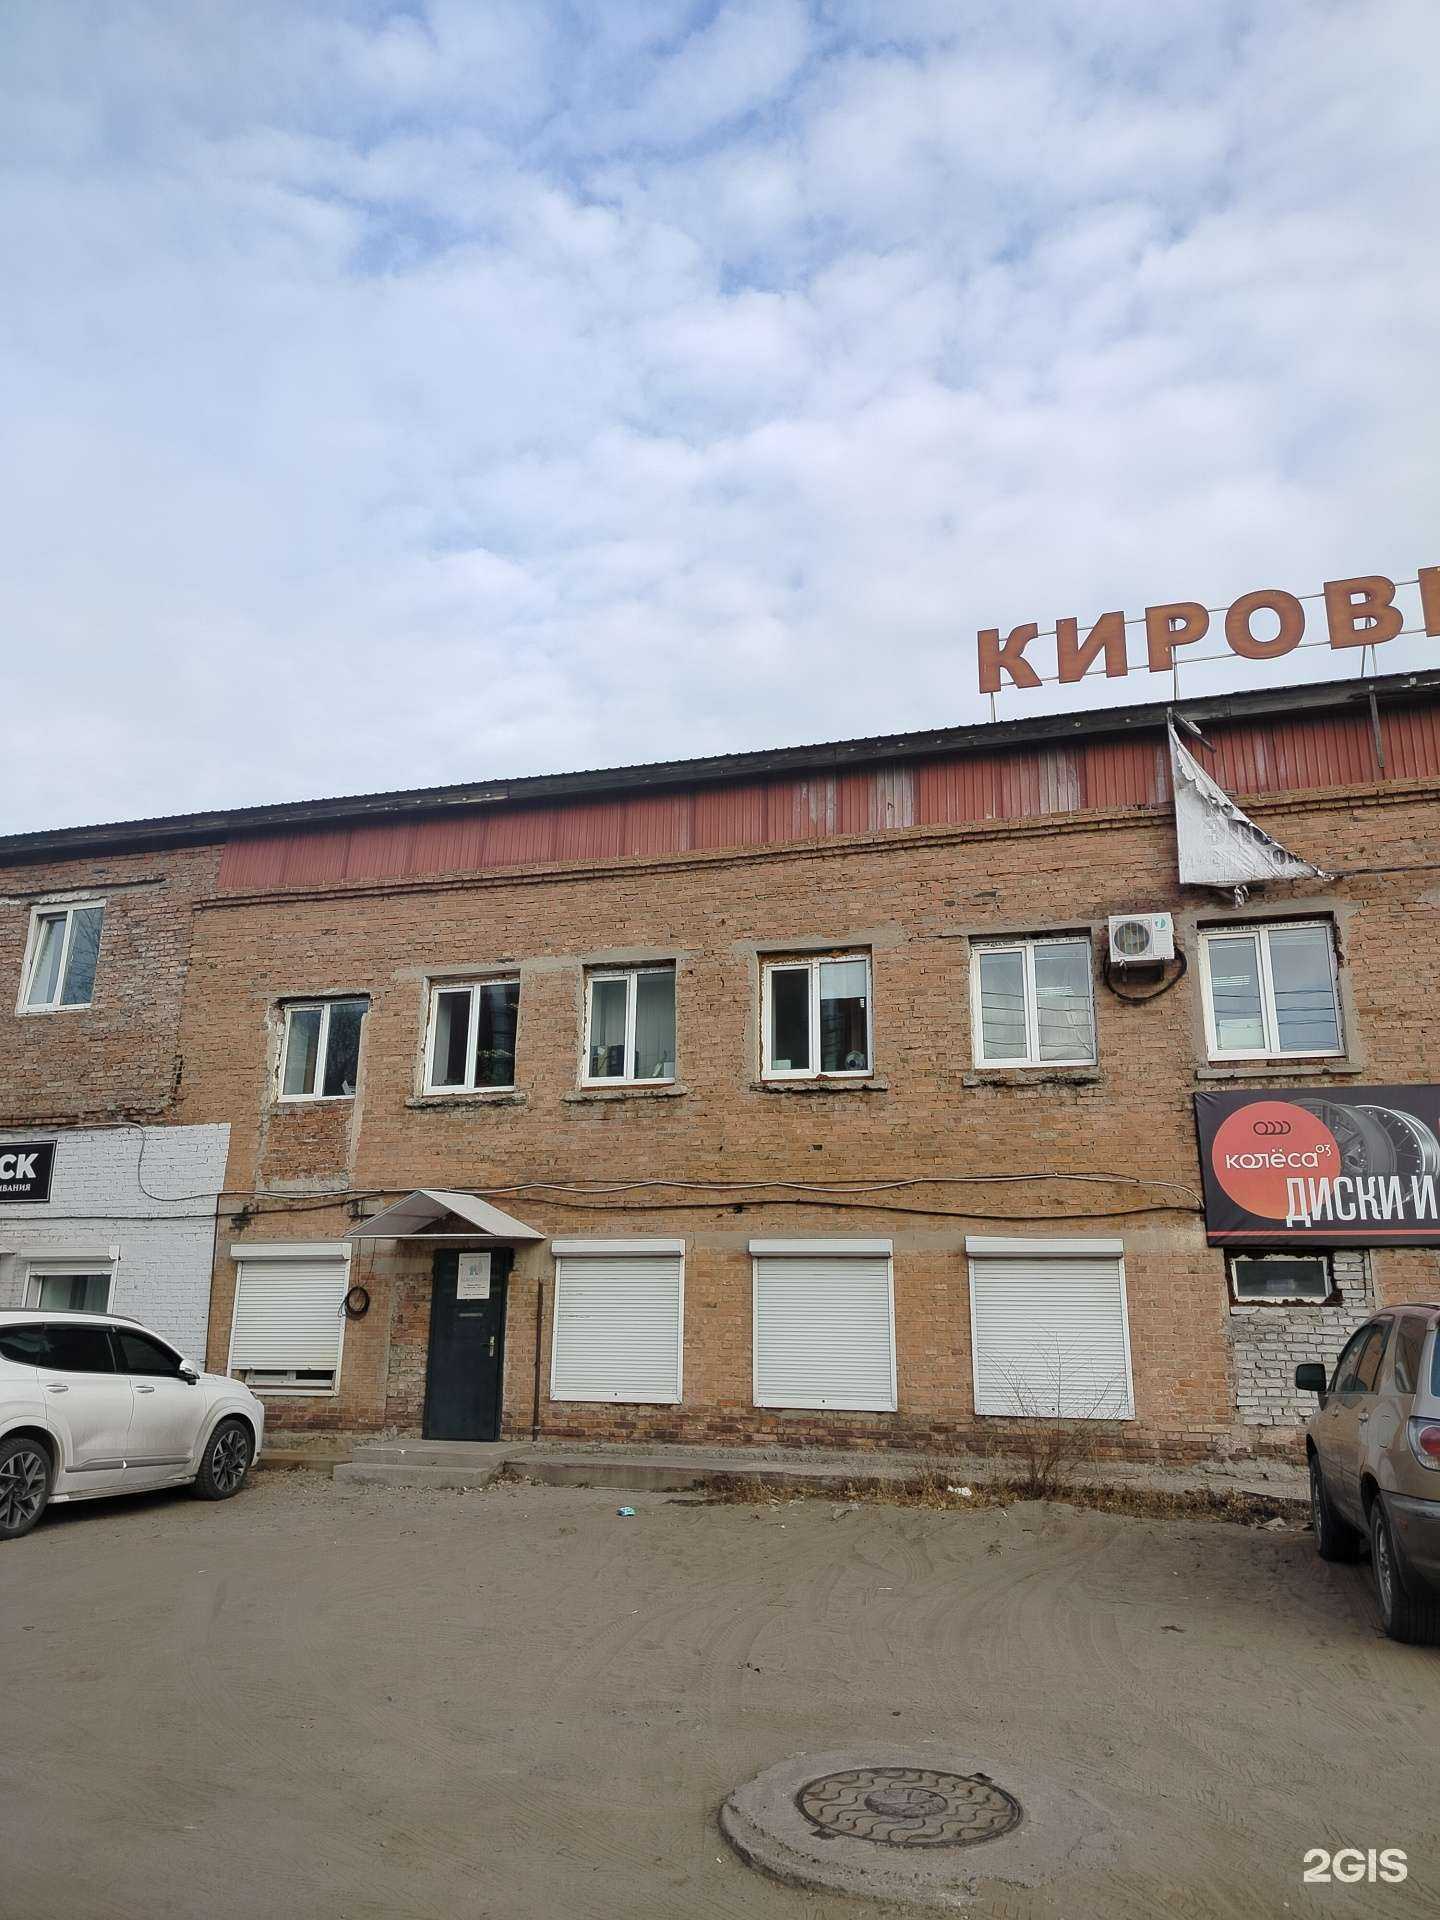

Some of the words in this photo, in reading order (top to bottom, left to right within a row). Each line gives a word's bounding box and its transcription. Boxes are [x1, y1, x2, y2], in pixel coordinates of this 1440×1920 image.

[977, 566, 1440, 693] КИРОВ
[1285, 1175, 1405, 1228] ДИСКИ
[1411, 1175, 1439, 1220] И
